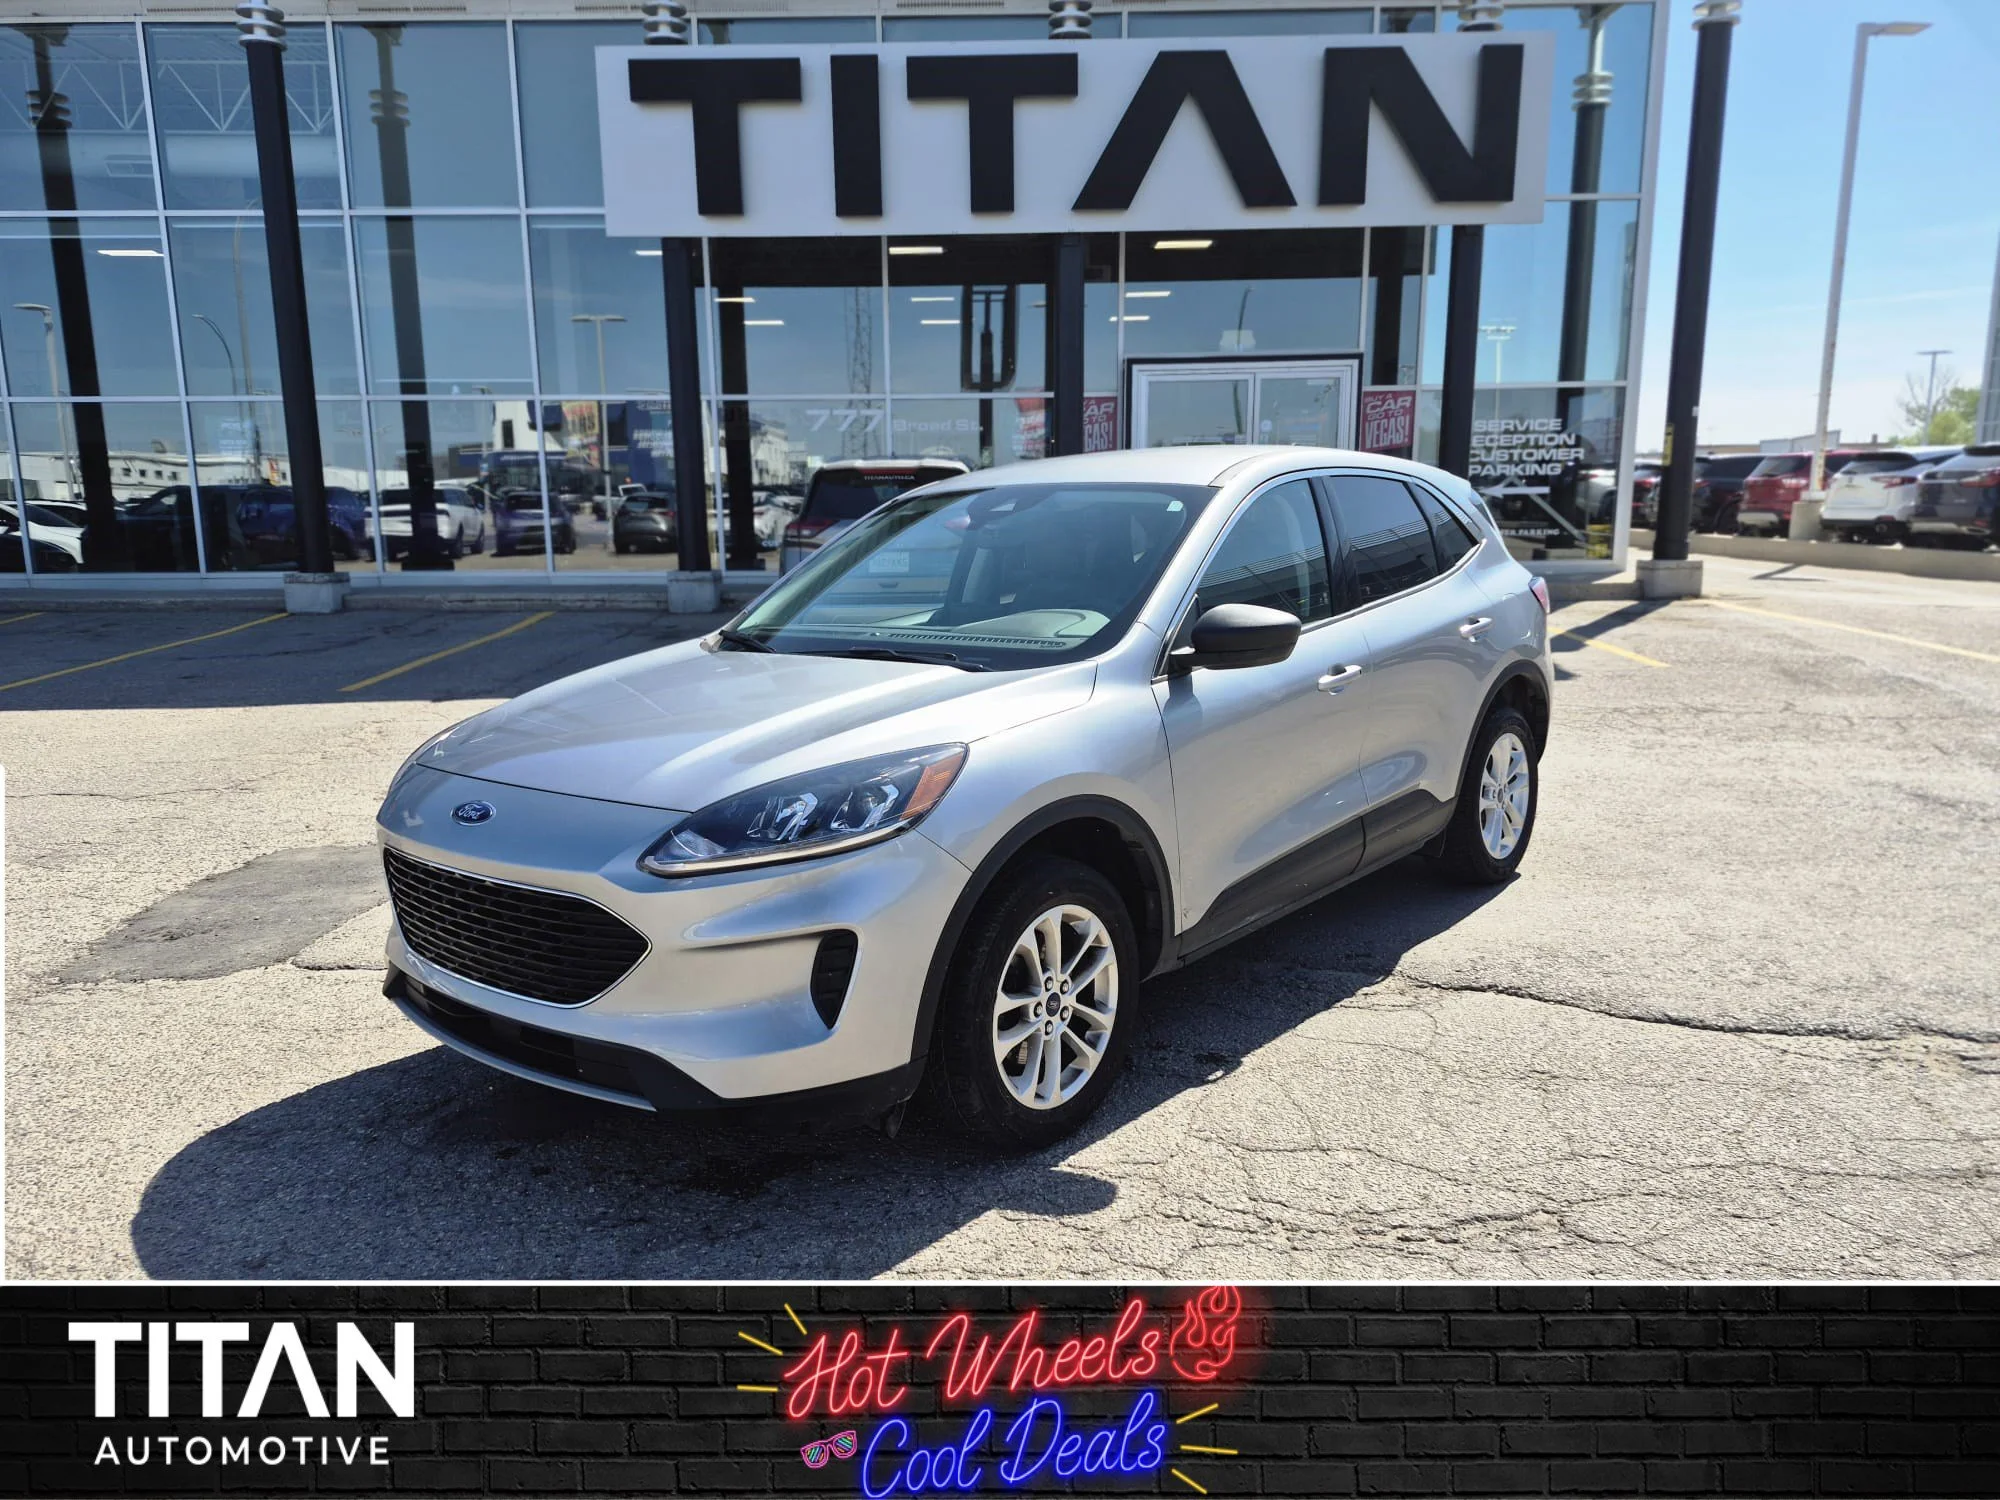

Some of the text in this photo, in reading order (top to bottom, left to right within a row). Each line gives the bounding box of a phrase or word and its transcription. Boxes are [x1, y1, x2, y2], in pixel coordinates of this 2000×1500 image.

[628, 43, 1524, 217] TITAN
[1083, 402, 1115, 417] AR
[1365, 396, 1412, 414] CAR
[805, 409, 885, 432] 777
[1367, 408, 1404, 421] GO TO
[1365, 414, 1410, 449] VEGAS!
[1473, 418, 1562, 432] SERVICE
[1470, 433, 1576, 447] ECEPTION
[1468, 463, 1562, 477] PARKING
